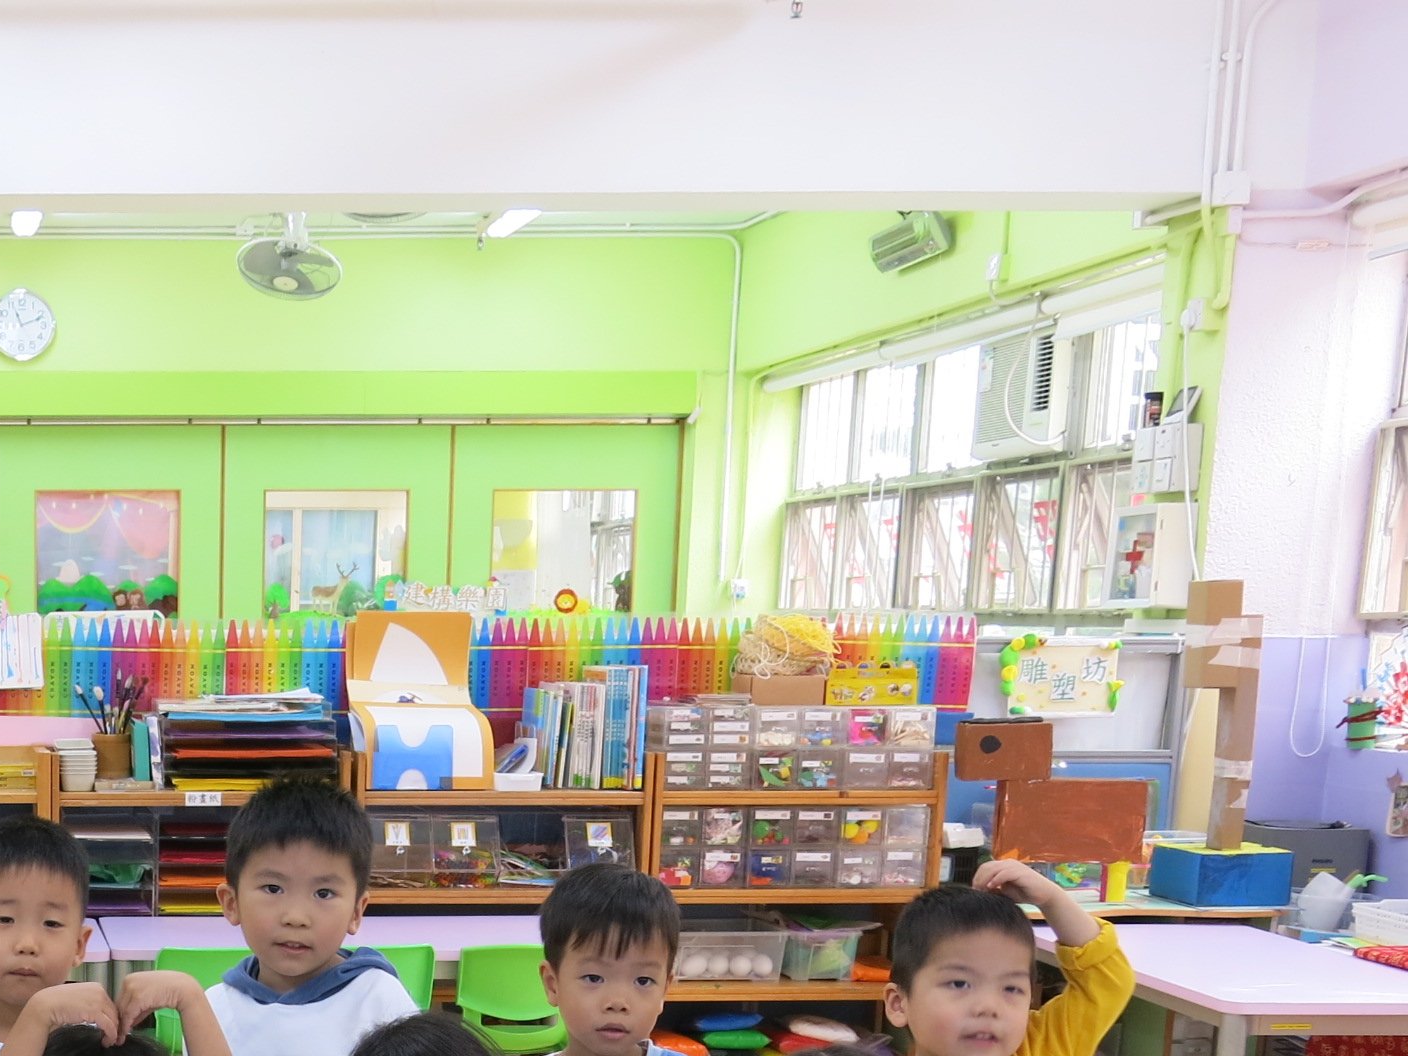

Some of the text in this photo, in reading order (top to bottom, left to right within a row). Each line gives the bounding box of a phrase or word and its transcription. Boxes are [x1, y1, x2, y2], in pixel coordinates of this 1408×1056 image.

[403, 582, 508, 610] 建構樂園
[1017, 656, 1109, 701] 雕塑坊
